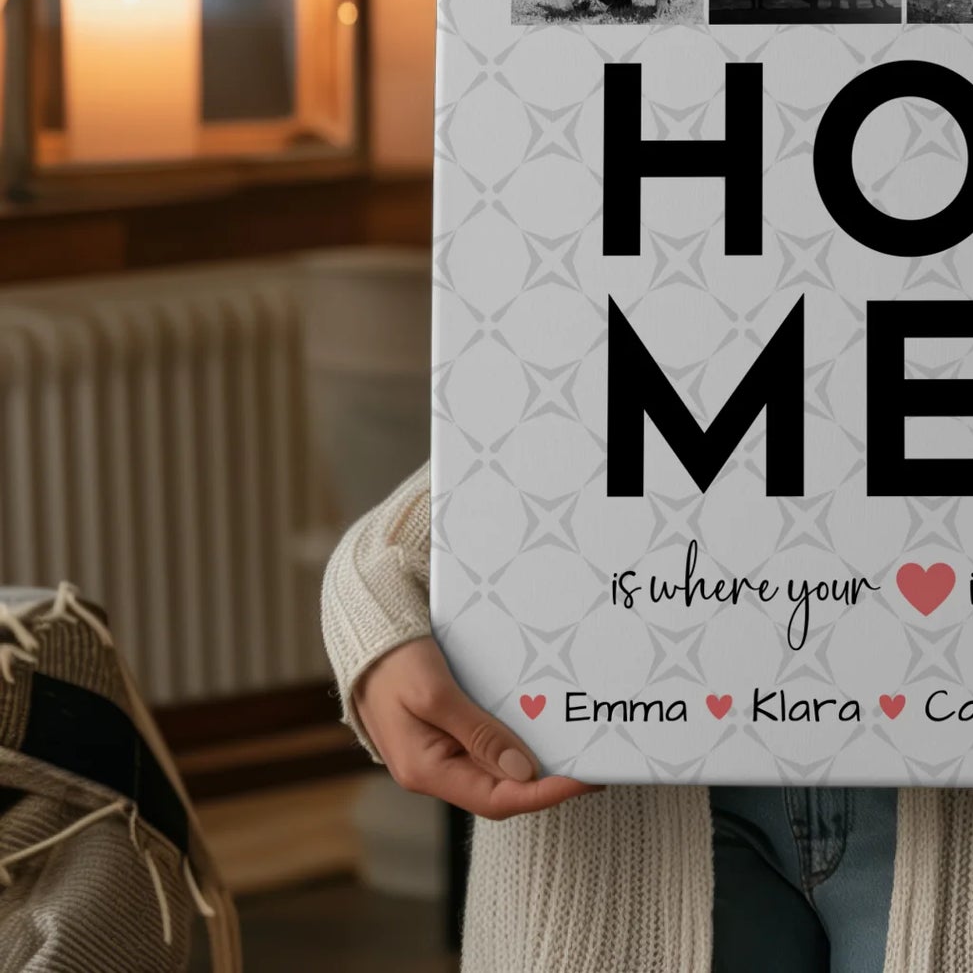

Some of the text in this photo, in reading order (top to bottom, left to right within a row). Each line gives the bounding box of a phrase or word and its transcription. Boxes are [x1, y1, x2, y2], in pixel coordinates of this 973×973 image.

[612, 570, 642, 610] is
[650, 539, 780, 608] where
[787, 577, 881, 651] your
[565, 691, 688, 723] Emma
[752, 687, 861, 723] Klara
